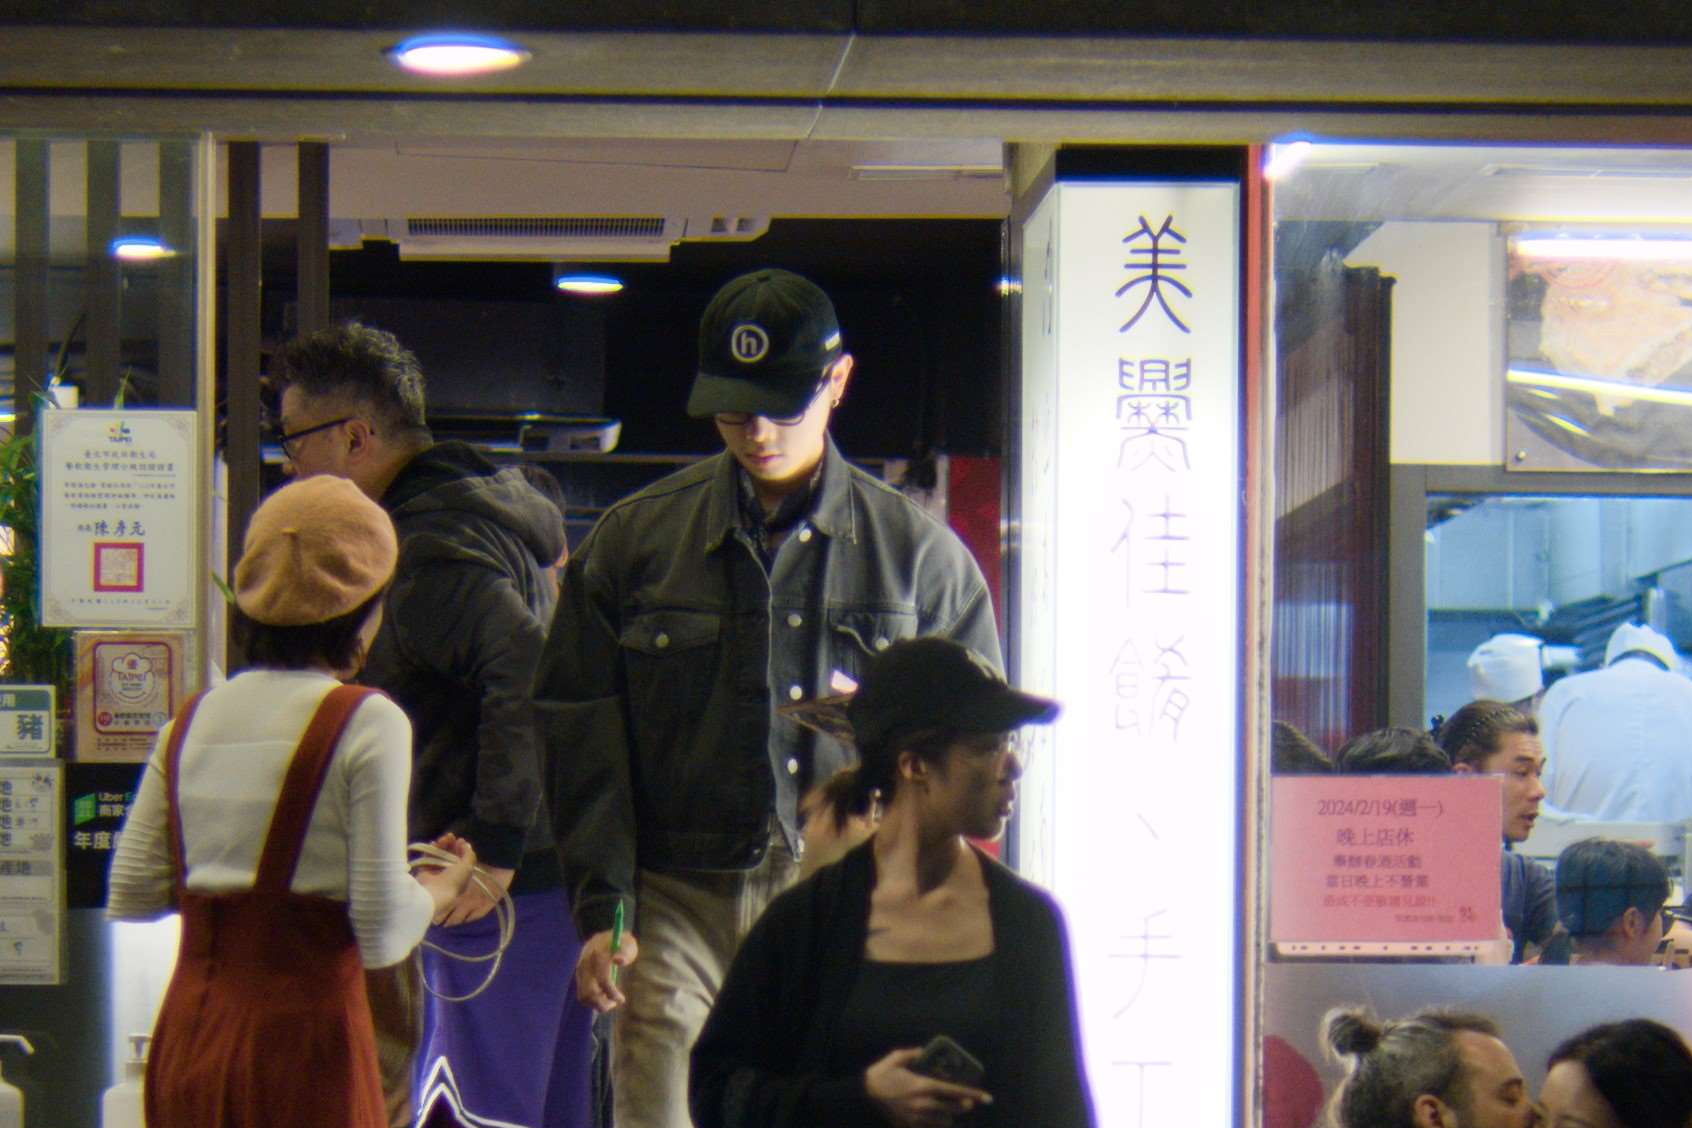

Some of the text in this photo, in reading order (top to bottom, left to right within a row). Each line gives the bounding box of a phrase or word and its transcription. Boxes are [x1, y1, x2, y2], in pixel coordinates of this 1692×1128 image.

[0, 693, 16, 709] 用
[16, 714, 43, 740] 豬
[98, 791, 123, 802] Uber
[99, 804, 129, 817] 商家
[1318, 799, 1444, 818] 2024/2/19(週一)
[73, 831, 116, 849] 年度
[1336, 827, 1415, 847] 晚上店休
